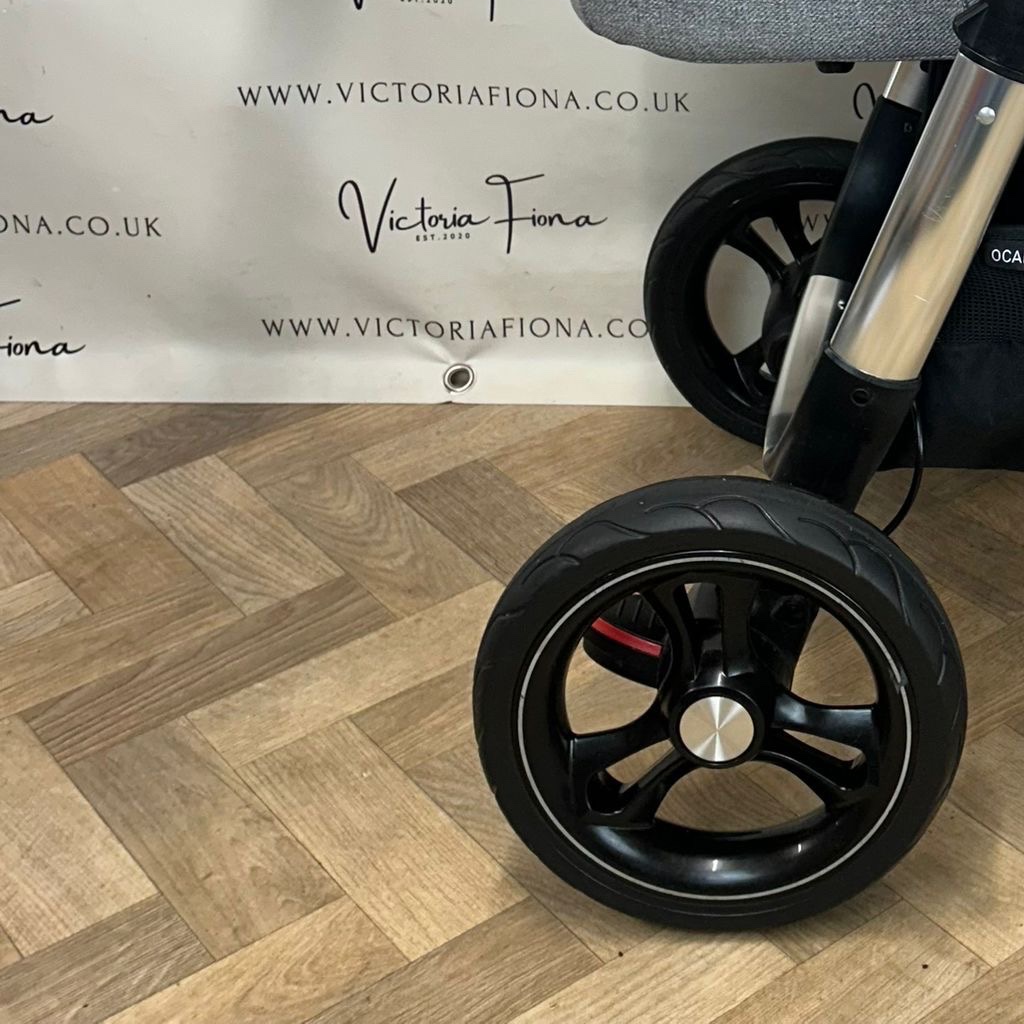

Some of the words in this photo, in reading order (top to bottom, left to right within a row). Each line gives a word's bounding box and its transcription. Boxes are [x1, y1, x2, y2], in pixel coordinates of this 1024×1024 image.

[237, 82, 690, 113] WWW.VICTORIAFIONA.CO.UK
[338, 177, 490, 254] Victoria
[485, 174, 607, 254] Fiona
[415, 233, 471, 243] EST.2020
